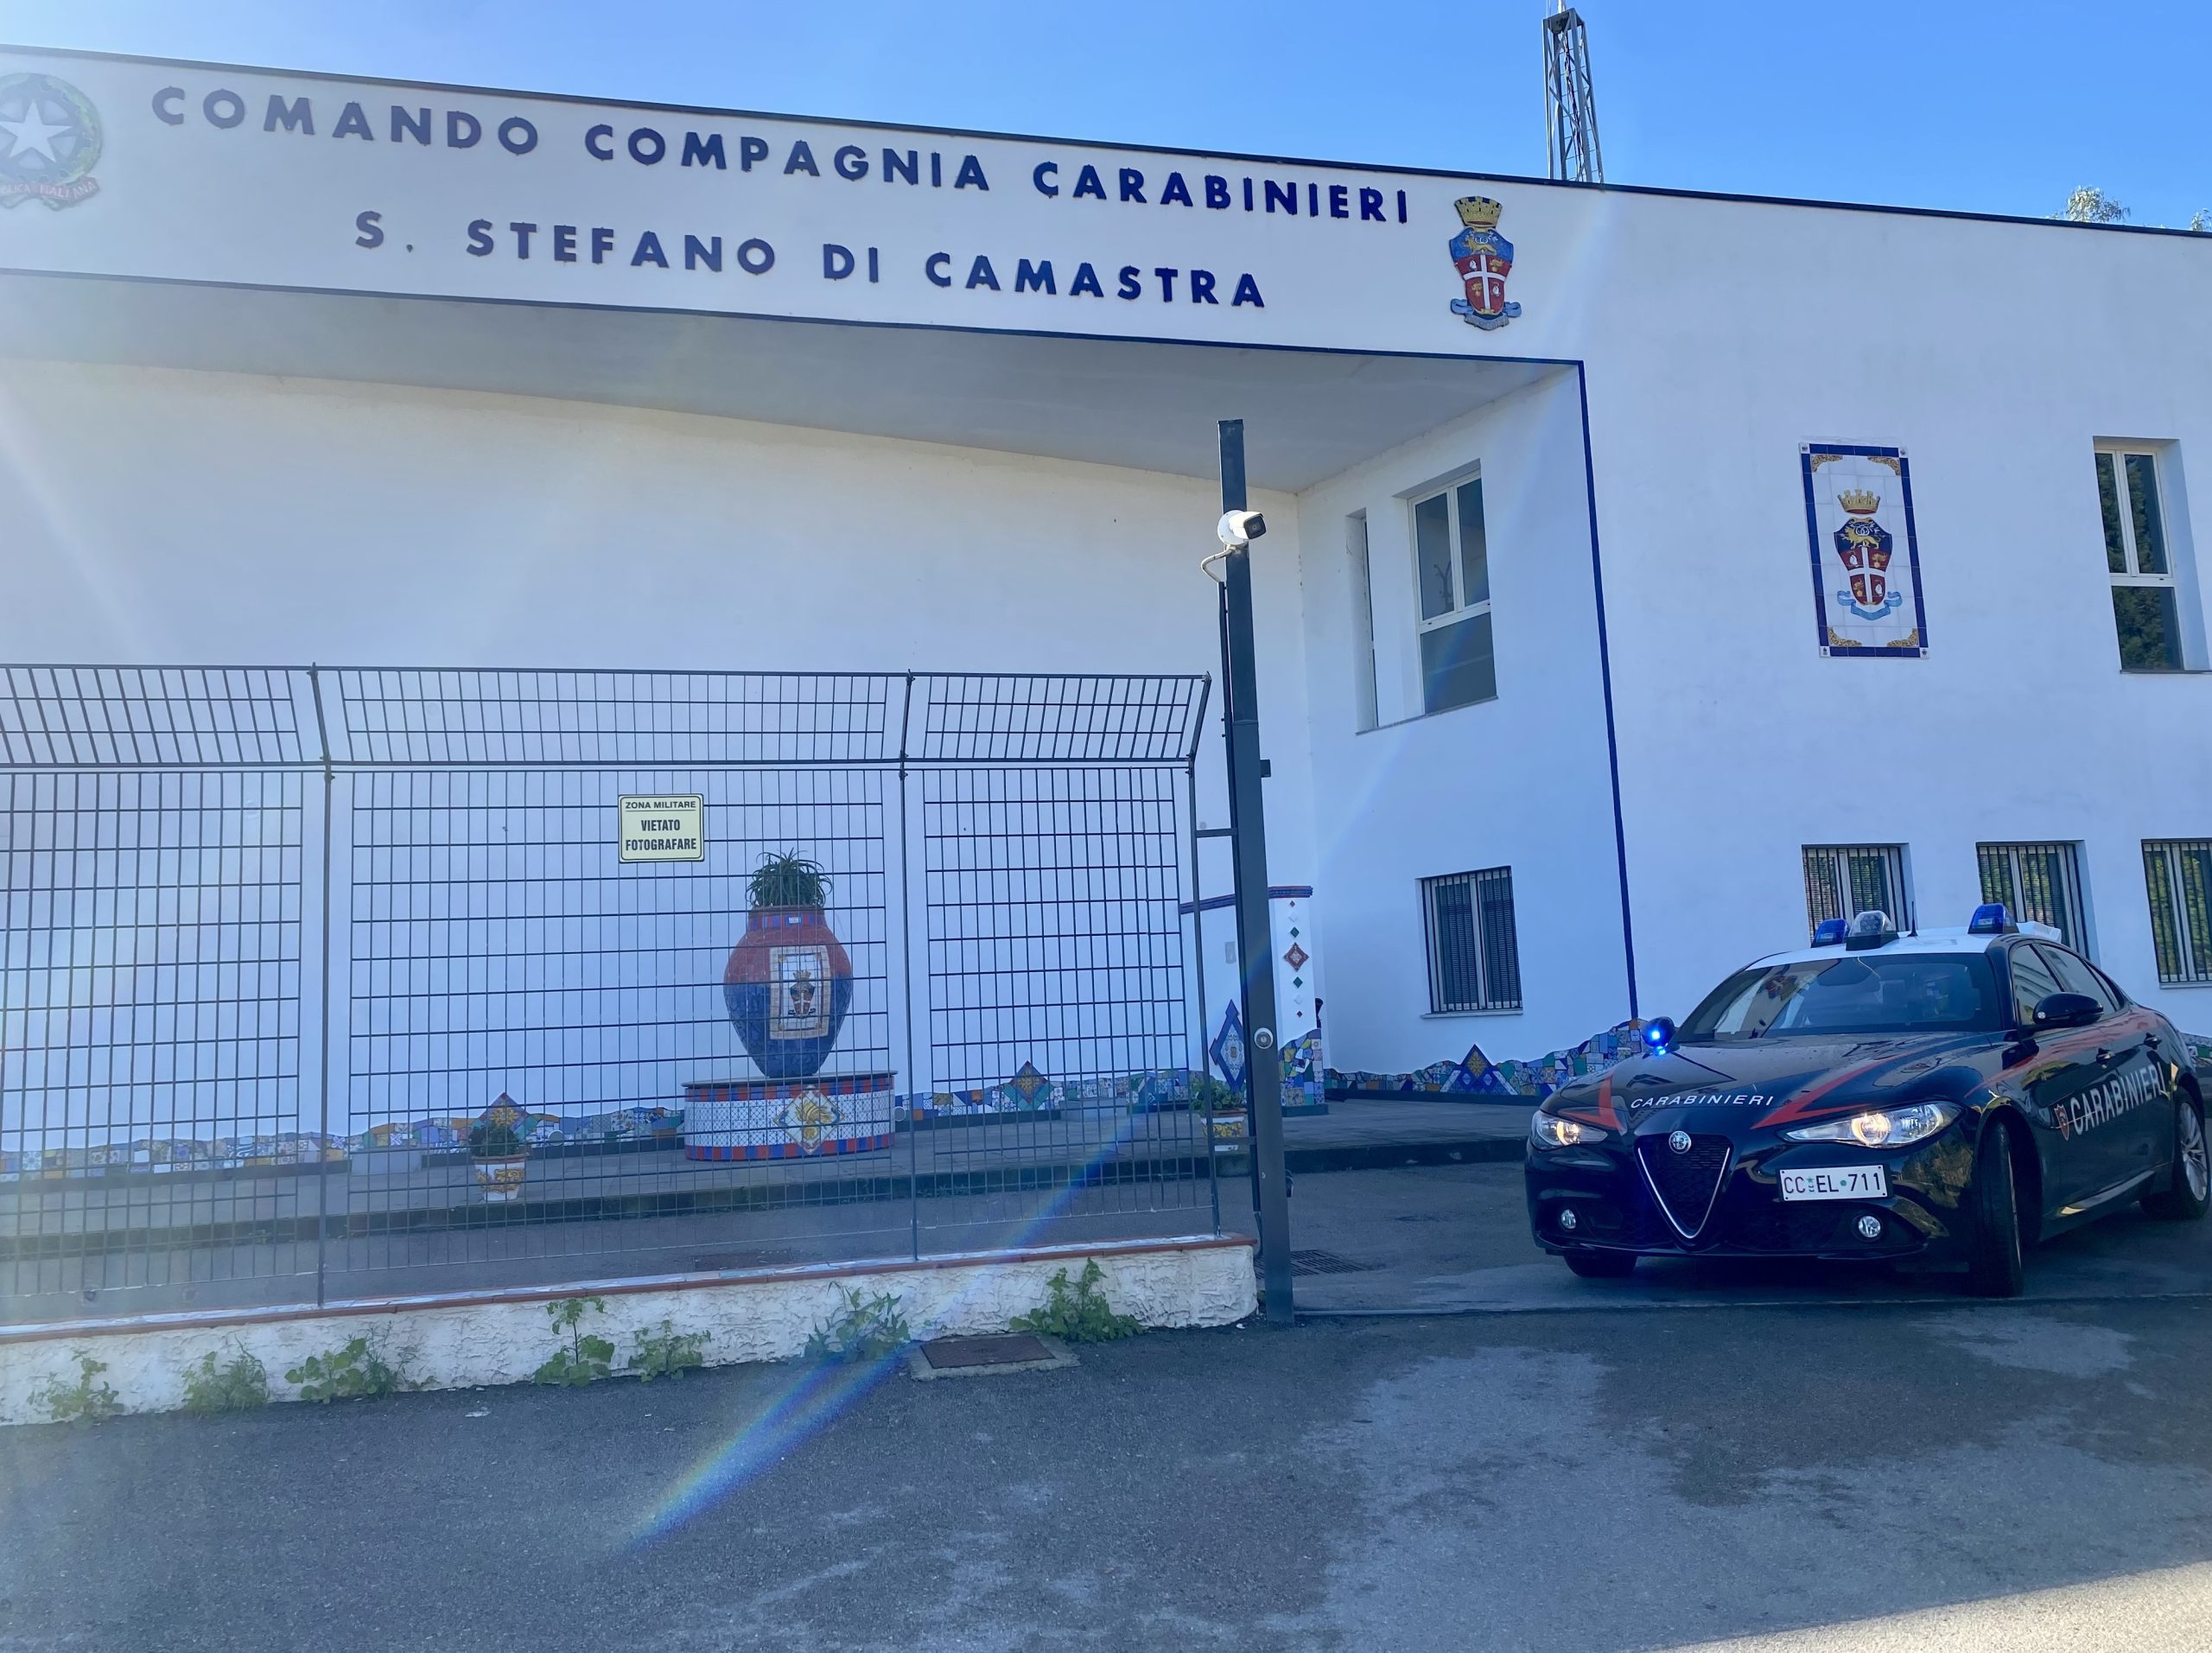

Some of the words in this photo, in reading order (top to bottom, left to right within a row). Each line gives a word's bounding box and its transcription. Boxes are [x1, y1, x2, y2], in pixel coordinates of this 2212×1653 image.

[151, 86, 539, 156] COMANDO
[584, 123, 990, 193] COMPAGNIA
[1033, 161, 1408, 225] CARABINIERI
[354, 210, 415, 253] S.
[466, 218, 775, 276] STEFANO
[823, 243, 880, 284] DI
[925, 251, 1267, 309] CAMASTRA
[626, 838, 696, 851] FOTOGRAFARE
[640, 819, 681, 831] VIETATO
[1630, 1094, 1774, 1109] CARABINIERI
[2069, 1061, 2167, 1136] CARABINIERI
